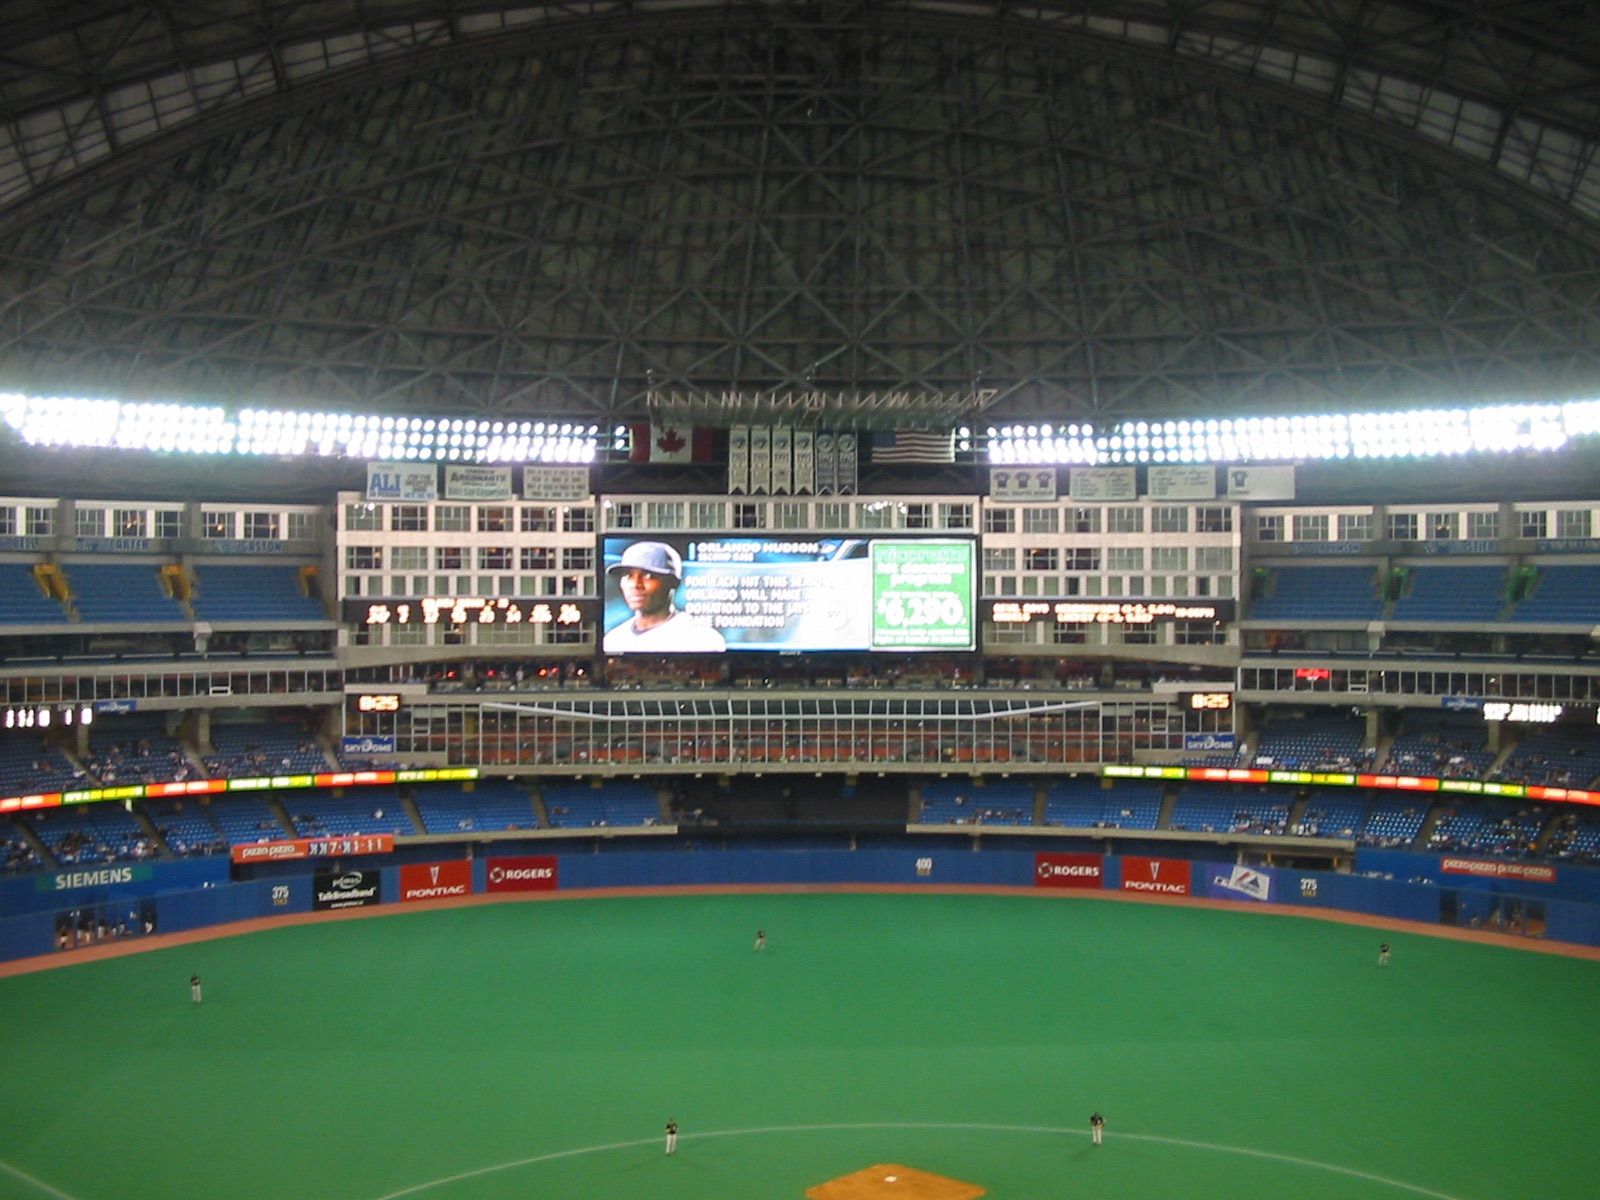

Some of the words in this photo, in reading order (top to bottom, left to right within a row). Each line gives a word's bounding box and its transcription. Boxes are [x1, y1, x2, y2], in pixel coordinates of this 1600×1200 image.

[697, 543, 761, 553] ORLANDO
[763, 543, 818, 553] HUDSON
[710, 576, 738, 587] EACH
[742, 576, 760, 587] HIT
[764, 576, 787, 587] THIS
[685, 589, 738, 601] ORLANDO
[741, 589, 768, 601] WILL
[771, 589, 801, 601] MAKE
[685, 602, 743, 615] DONATION
[744, 602, 760, 615] TO
[762, 602, 784, 615] THE
[715, 615, 785, 627] FOUNDATION
[506, 868, 553, 880] ROGERS
[1053, 865, 1099, 877] ROGERS
[56, 867, 132, 890] SIEMENS
[406, 885, 465, 899] PONTIAC
[1124, 880, 1185, 893] PONTIAC
